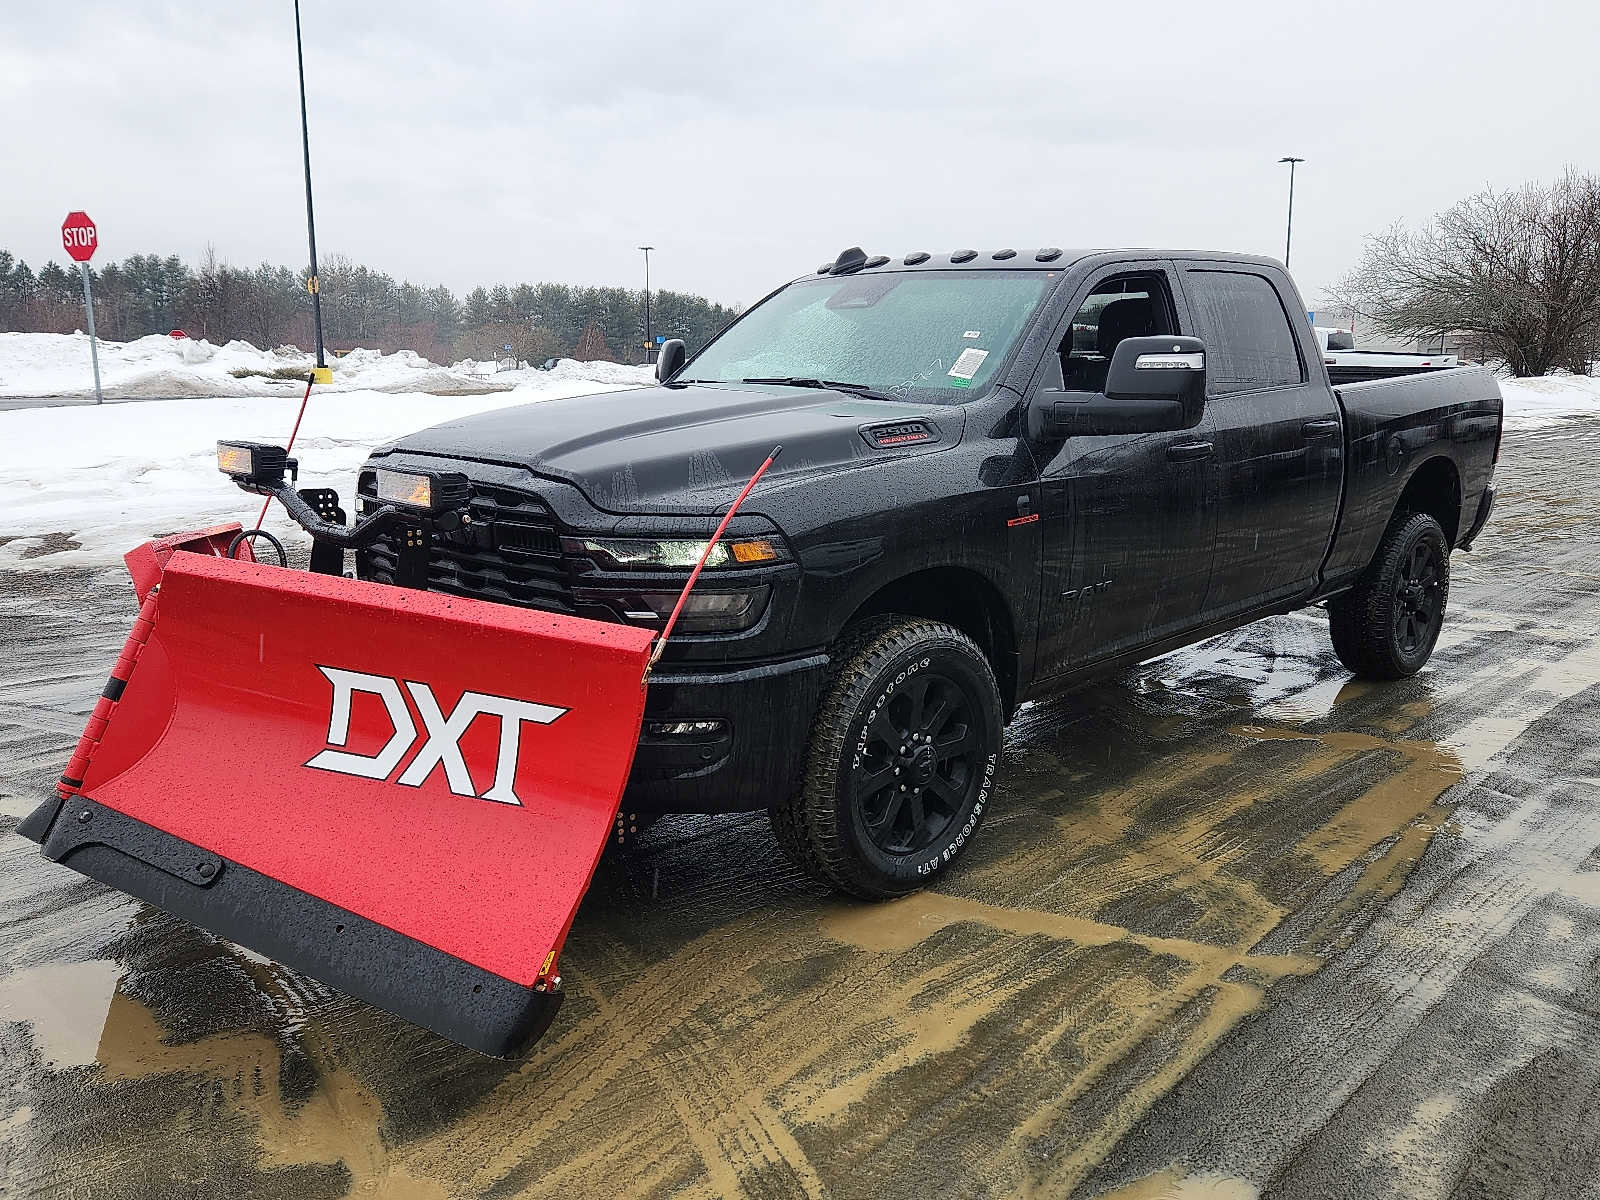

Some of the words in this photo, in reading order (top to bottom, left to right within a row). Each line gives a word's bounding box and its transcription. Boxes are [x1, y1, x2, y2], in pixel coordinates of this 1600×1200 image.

[63, 226, 95, 247] STOP
[872, 424, 923, 438] 2500
[300, 663, 574, 807] DXT
[944, 753, 997, 862] TRANSFORCE
